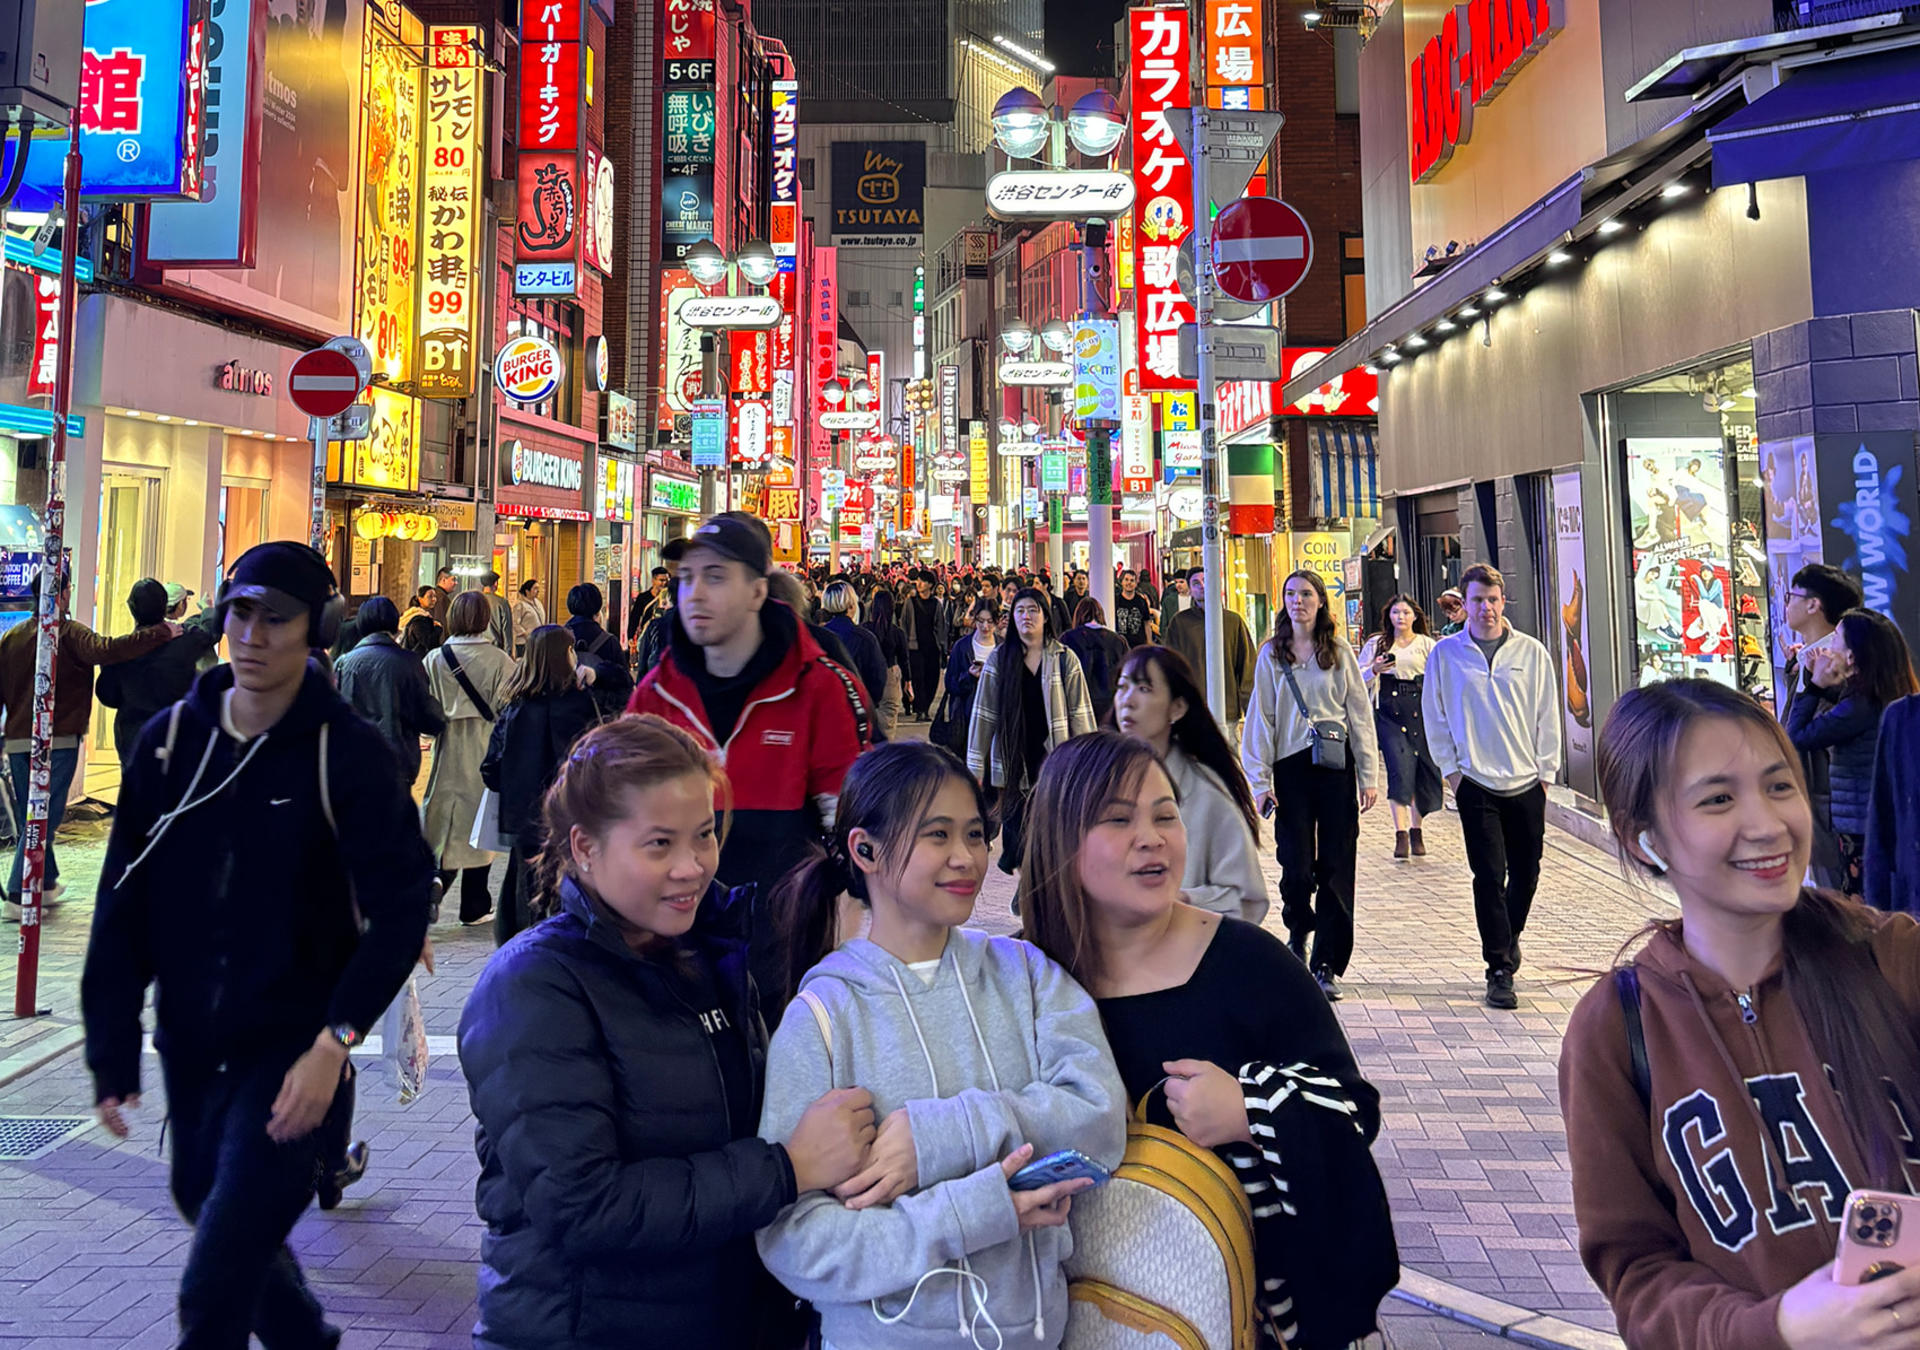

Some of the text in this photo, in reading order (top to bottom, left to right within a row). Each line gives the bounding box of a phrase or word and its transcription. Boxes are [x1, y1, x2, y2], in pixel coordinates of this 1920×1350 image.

[538, 3, 562, 143] バーガーキング
[264, 70, 297, 109] tmos
[430, 75, 450, 143] サワー
[452, 70, 472, 141] レモン
[668, 94, 689, 154] 無呼吸
[692, 94, 713, 153] いびき
[434, 147, 464, 168] 80
[681, 165, 699, 176] 4F
[428, 186, 469, 201] 秘伝
[995, 183, 1127, 201] 渋谷センター街
[837, 210, 921, 224] TSUTAYA
[428, 205, 465, 285] かわ串
[840, 236, 916, 246] www.tsutaya.co.jp
[518, 271, 574, 286] センタービル
[428, 291, 463, 314] 99
[425, 340, 463, 371] B1
[503, 349, 551, 374] BURGER
[222, 360, 273, 396] atmos
[505, 361, 553, 389] KING
[522, 448, 560, 487] BURGER
[560, 457, 582, 490] KING
[1130, 480, 1146, 491] B1
[767, 490, 798, 518] 豚
[1853, 451, 1886, 567] WORLD
[1304, 542, 1336, 555] COIN
[1295, 559, 1344, 572] LOCKE
